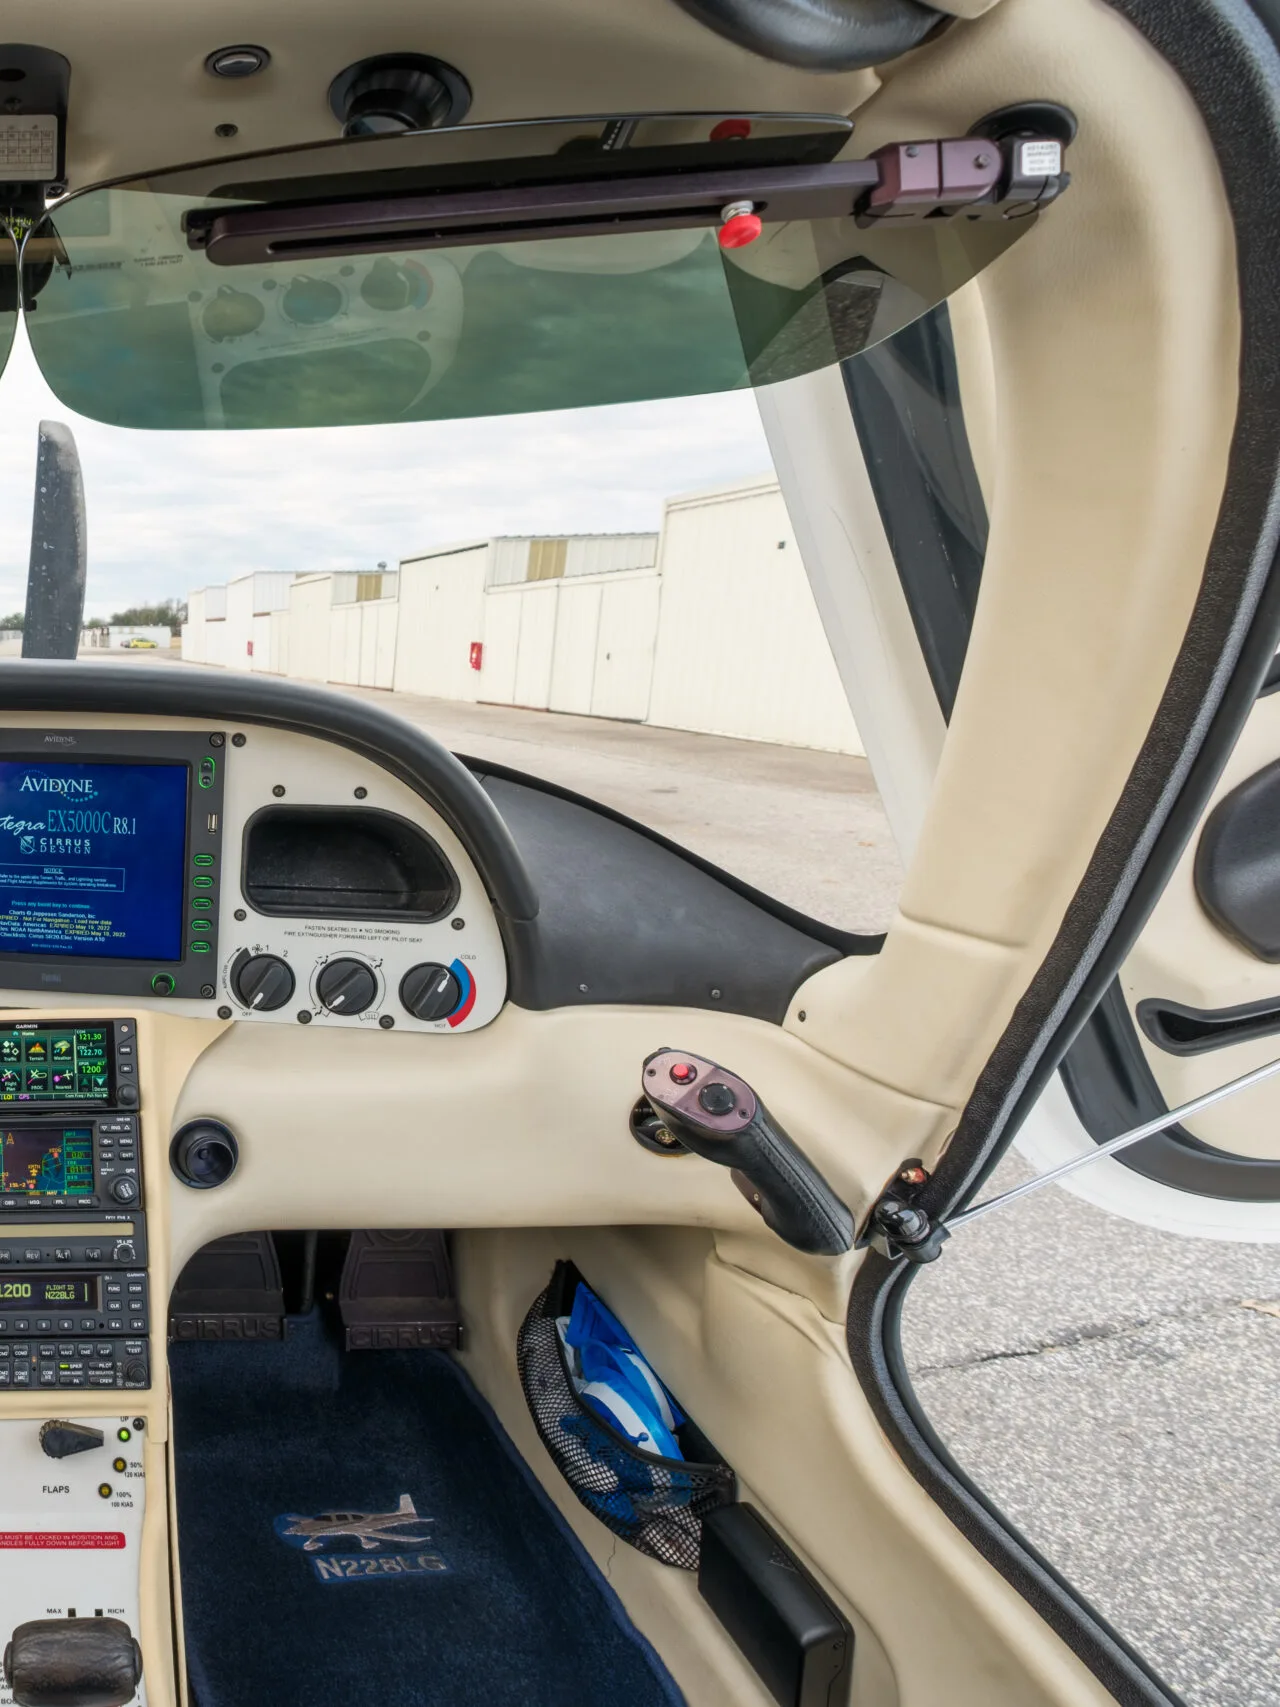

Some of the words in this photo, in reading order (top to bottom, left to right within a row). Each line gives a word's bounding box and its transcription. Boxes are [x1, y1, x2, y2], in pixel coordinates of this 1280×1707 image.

[19, 776, 93, 793] AVIDYNE
[48, 810, 111, 833] EX5000C
[113, 817, 136, 835] R8.1
[40, 838, 90, 846] CIRRUS
[40, 846, 91, 854] DESIGN
[45, 1291, 75, 1299] N228LG
[315, 1554, 448, 1580] N228LG
